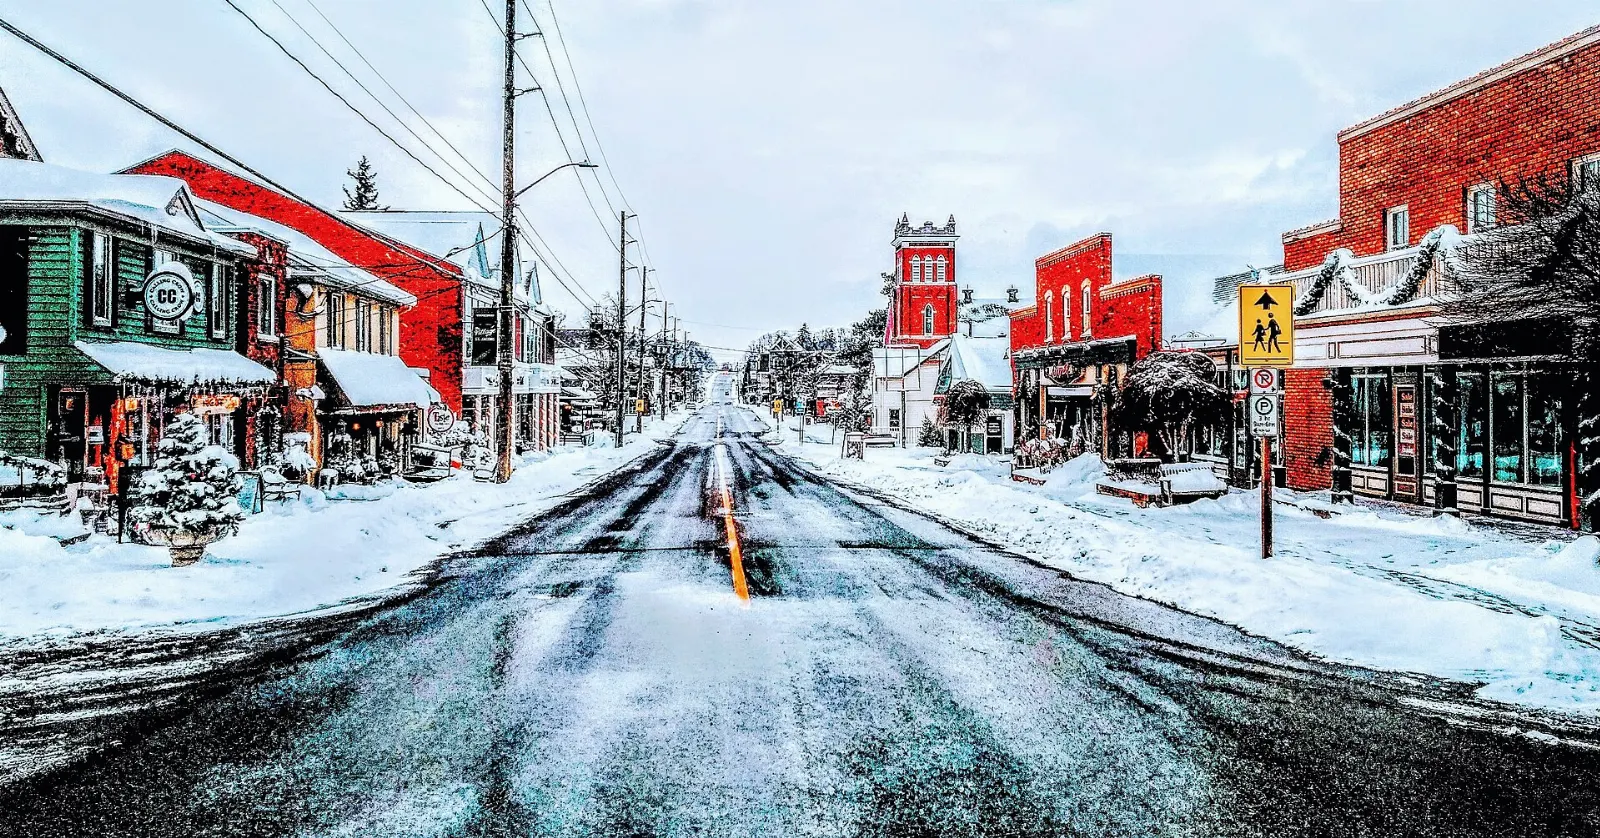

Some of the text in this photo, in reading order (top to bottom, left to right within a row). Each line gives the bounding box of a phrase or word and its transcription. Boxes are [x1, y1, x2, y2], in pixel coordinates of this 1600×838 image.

[157, 288, 177, 304] CC
[1401, 392, 1413, 401] Sale
[1401, 405, 1414, 414] Sale
[1401, 418, 1413, 428] Sale
[1401, 431, 1414, 440] Sale
